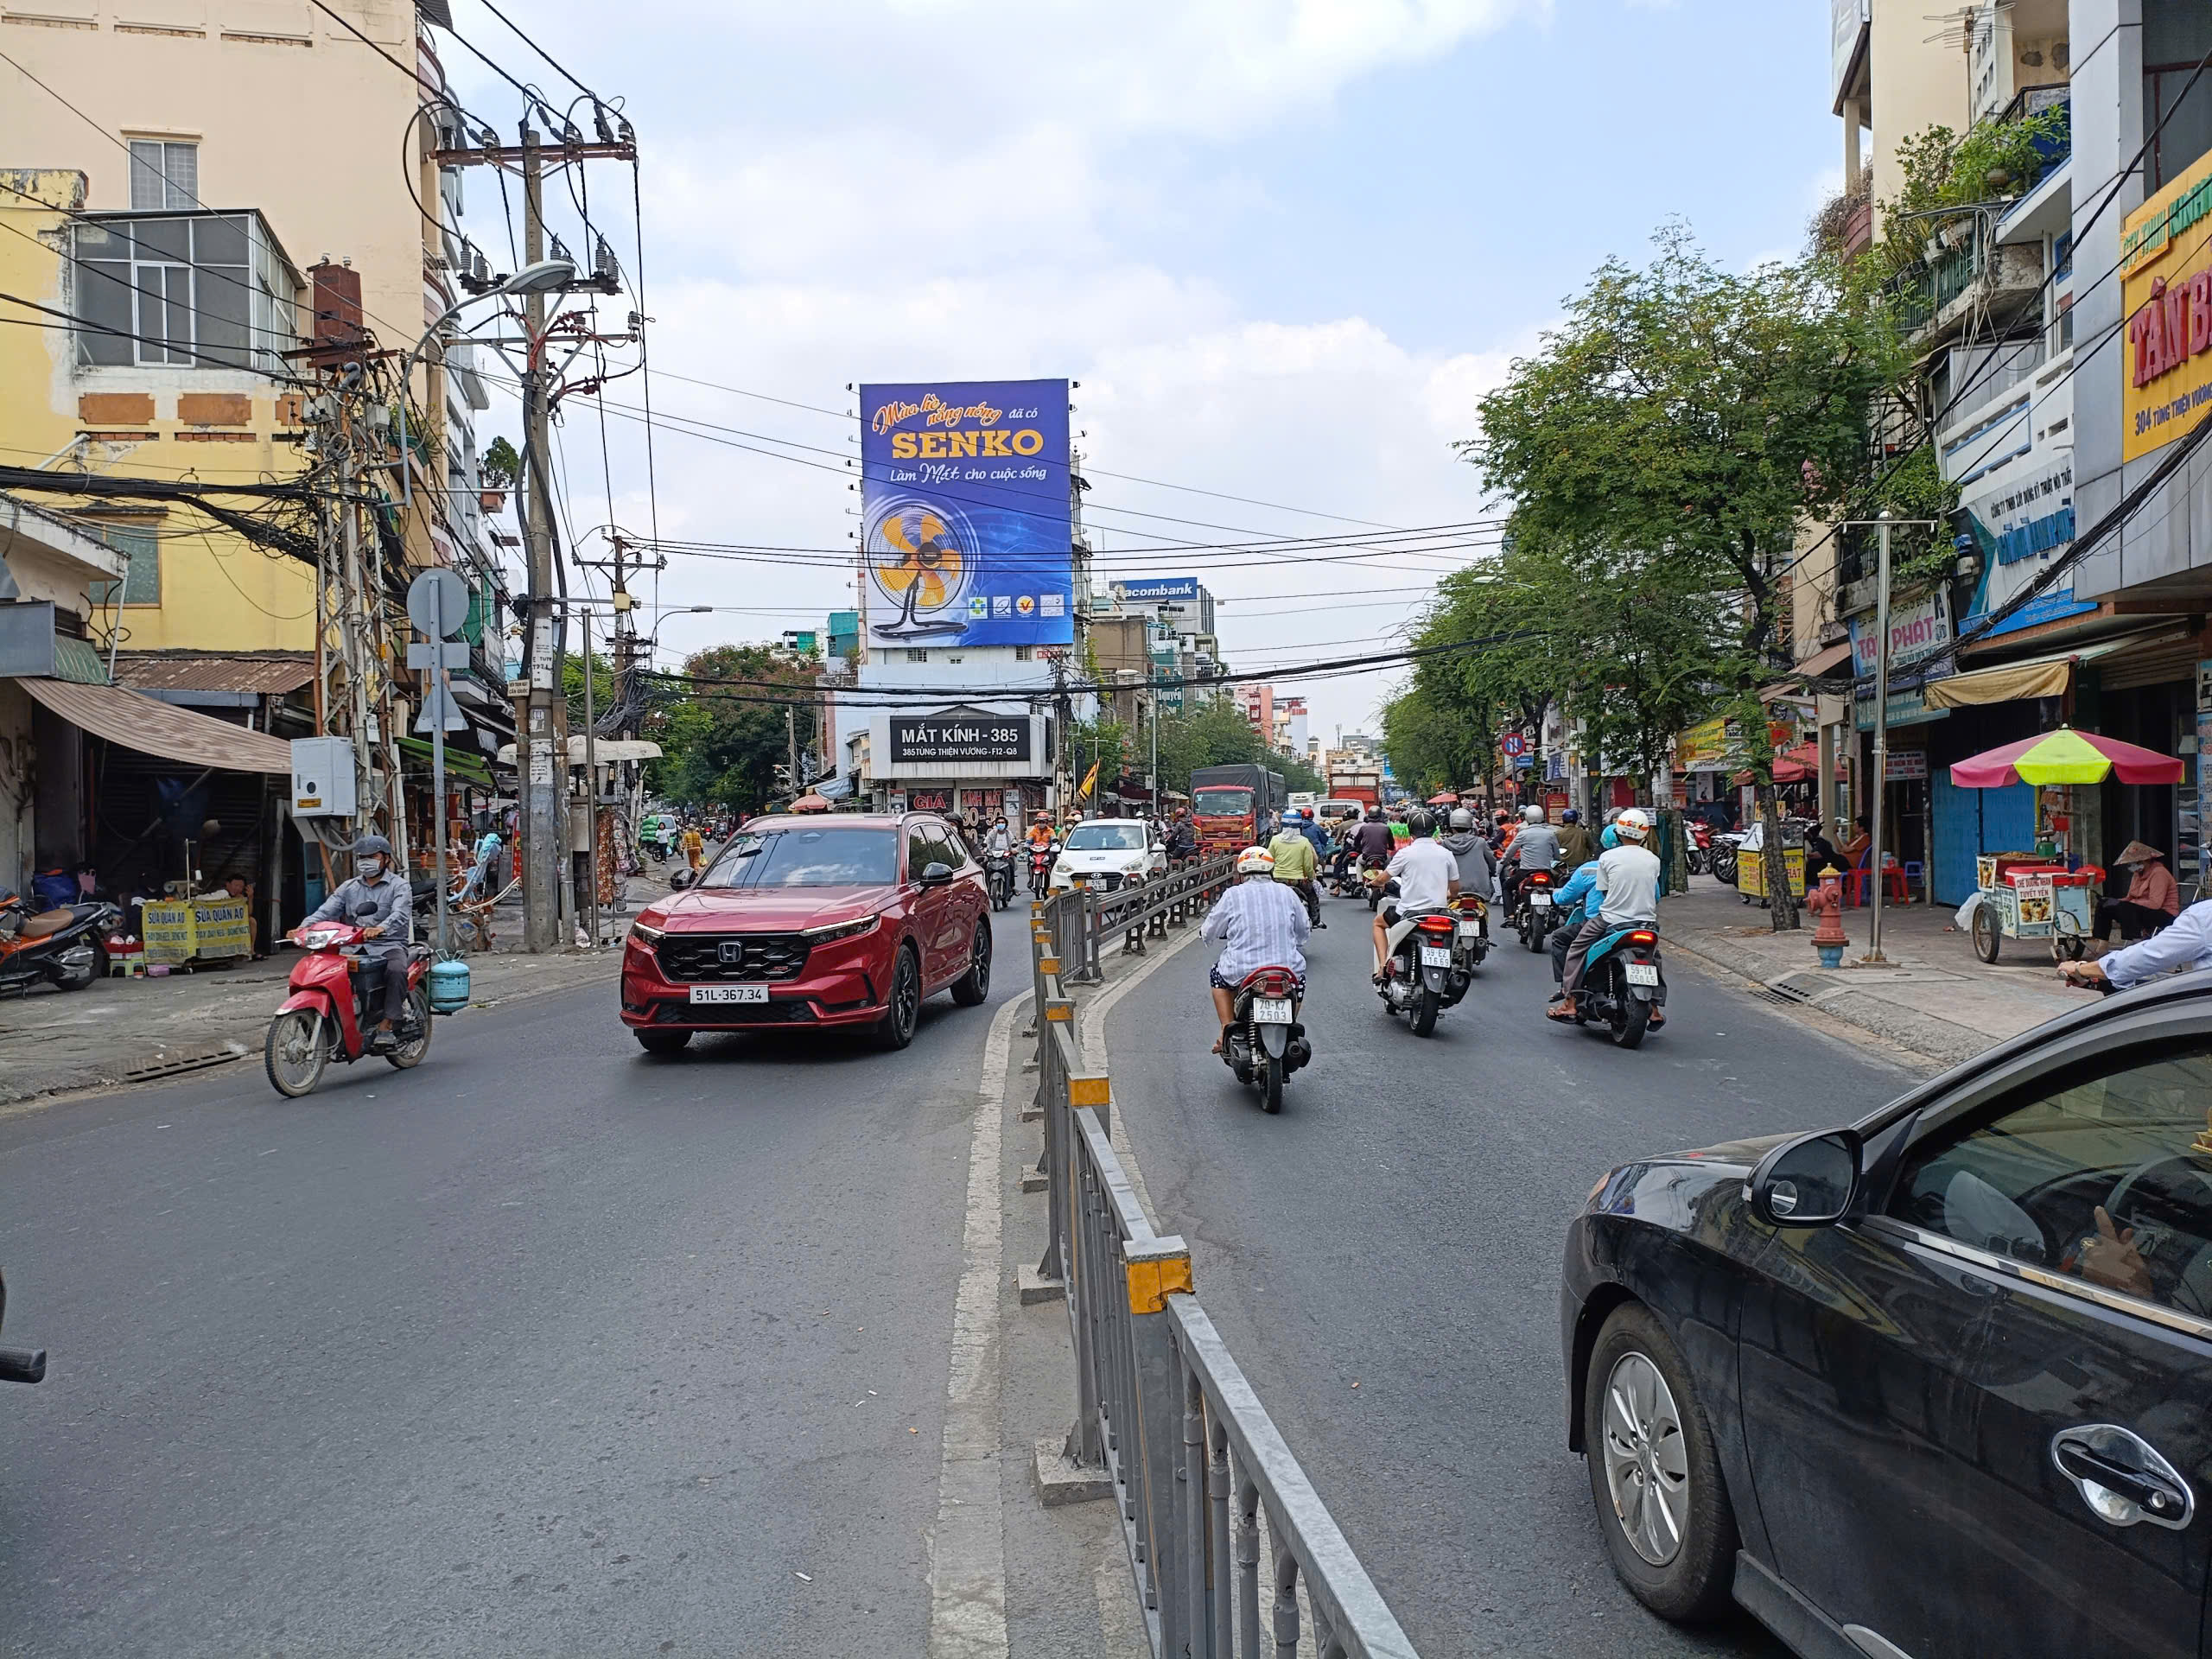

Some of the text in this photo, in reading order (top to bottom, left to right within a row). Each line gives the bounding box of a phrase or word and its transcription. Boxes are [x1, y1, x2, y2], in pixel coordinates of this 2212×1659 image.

[2129, 276, 2190, 388] TÂN
[873, 394, 940, 435] Mùa hè
[926, 402, 1038, 427] nắng nóng đã có
[2135, 406, 2151, 435] 304
[2171, 392, 2190, 418] THIỆN
[892, 429, 1044, 459] SENKO
[890, 463, 1046, 483] Làm Mát cho cuộc sống
[1121, 582, 1192, 597] acombank
[1891, 615, 1934, 650] PHÁT
[901, 723, 938, 743] MẮT
[942, 724, 979, 742] KÍNH
[990, 728, 1019, 742] 385
[938, 747, 959, 757] THIỆN
[913, 791, 946, 810] GIÁ
[962, 790, 982, 806] KÍNH
[2019, 887, 2036, 899] TUYẾT
[2037, 887, 2049, 897] YẾN
[195, 906, 212, 923] SỬA
[213, 905, 232, 923] QUẦN
[696, 989, 761, 1001] 51L-367.34
[1260, 1000, 1285, 1010] 70-K7
[1260, 1011, 1286, 1021] 2503
